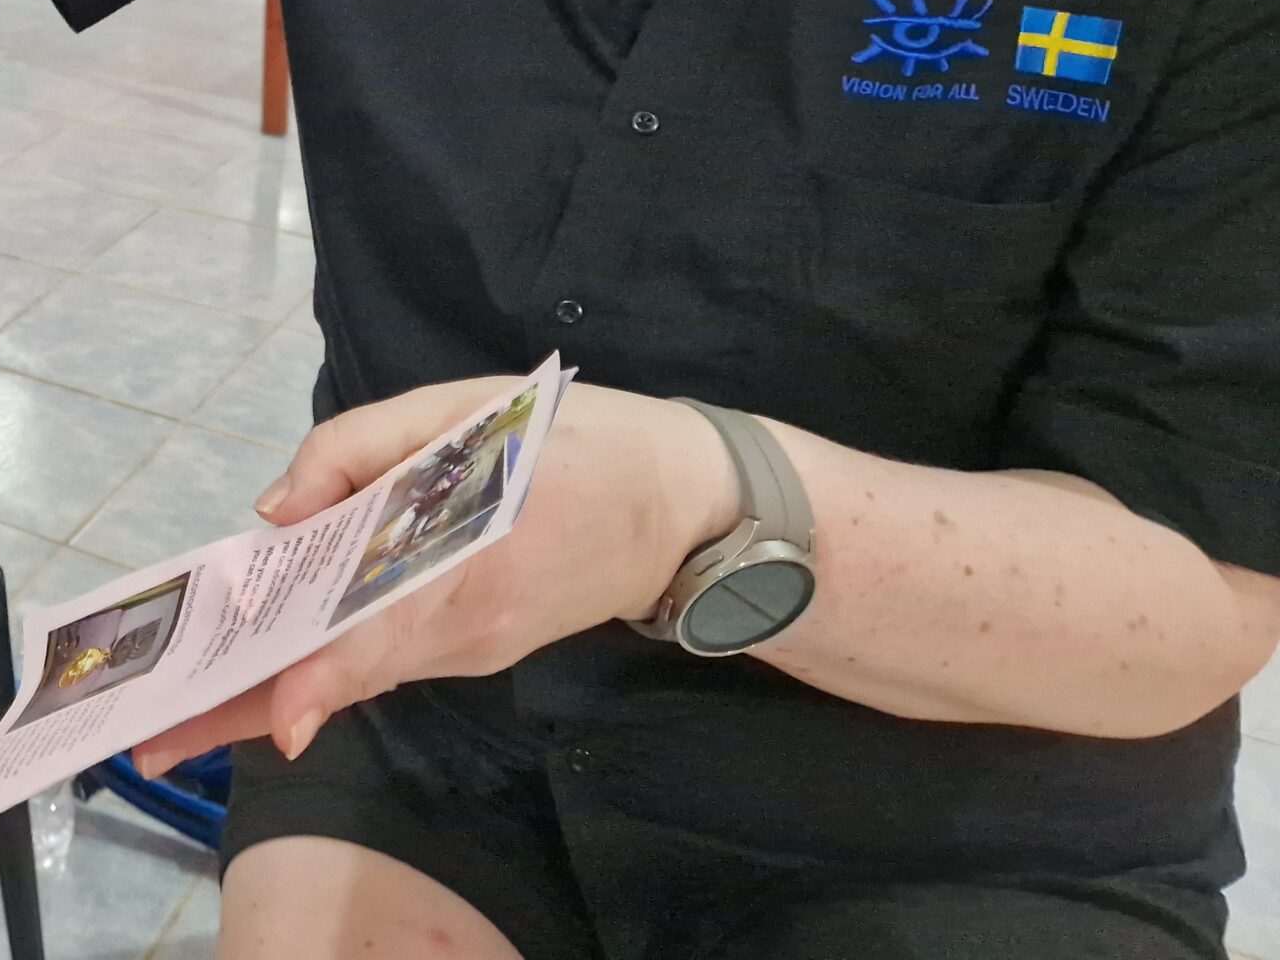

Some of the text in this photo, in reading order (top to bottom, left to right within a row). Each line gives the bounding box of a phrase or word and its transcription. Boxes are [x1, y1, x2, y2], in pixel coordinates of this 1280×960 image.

[842, 75, 980, 101] VISION FOR ALL
[1006, 85, 1111, 122] SWEDEN
